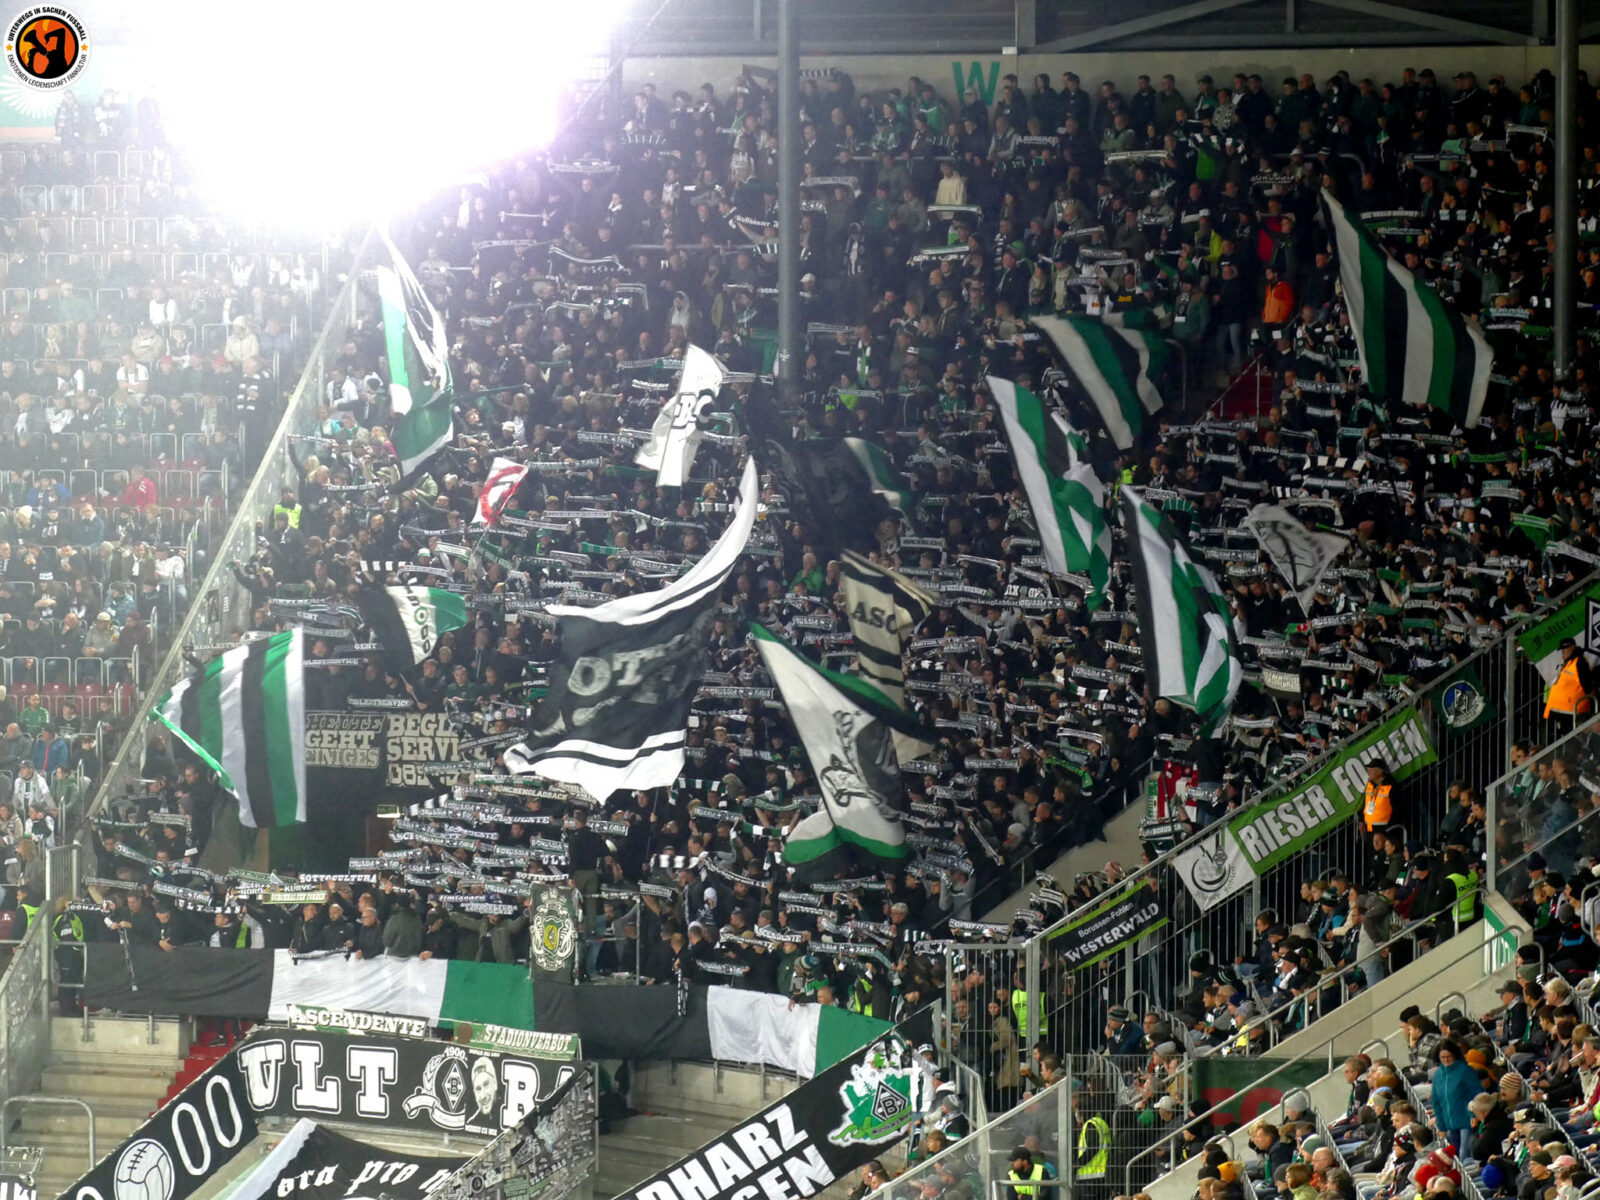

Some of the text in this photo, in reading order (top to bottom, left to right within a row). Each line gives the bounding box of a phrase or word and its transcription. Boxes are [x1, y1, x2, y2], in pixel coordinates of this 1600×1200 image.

[305, 730, 375, 749] GEHT
[1237, 783, 1336, 864] RIESER
[300, 873, 377, 884] SOTTOCULTURA
[1064, 902, 1160, 963] WESTERWALD
[1078, 901, 1135, 938] Borussen-Fohlen
[290, 1007, 424, 1038] ASCENDENTE
[444, 1047, 466, 1060] 1900
[483, 1025, 572, 1052] STADIONVERBOT
[343, 1160, 420, 1196] pro
